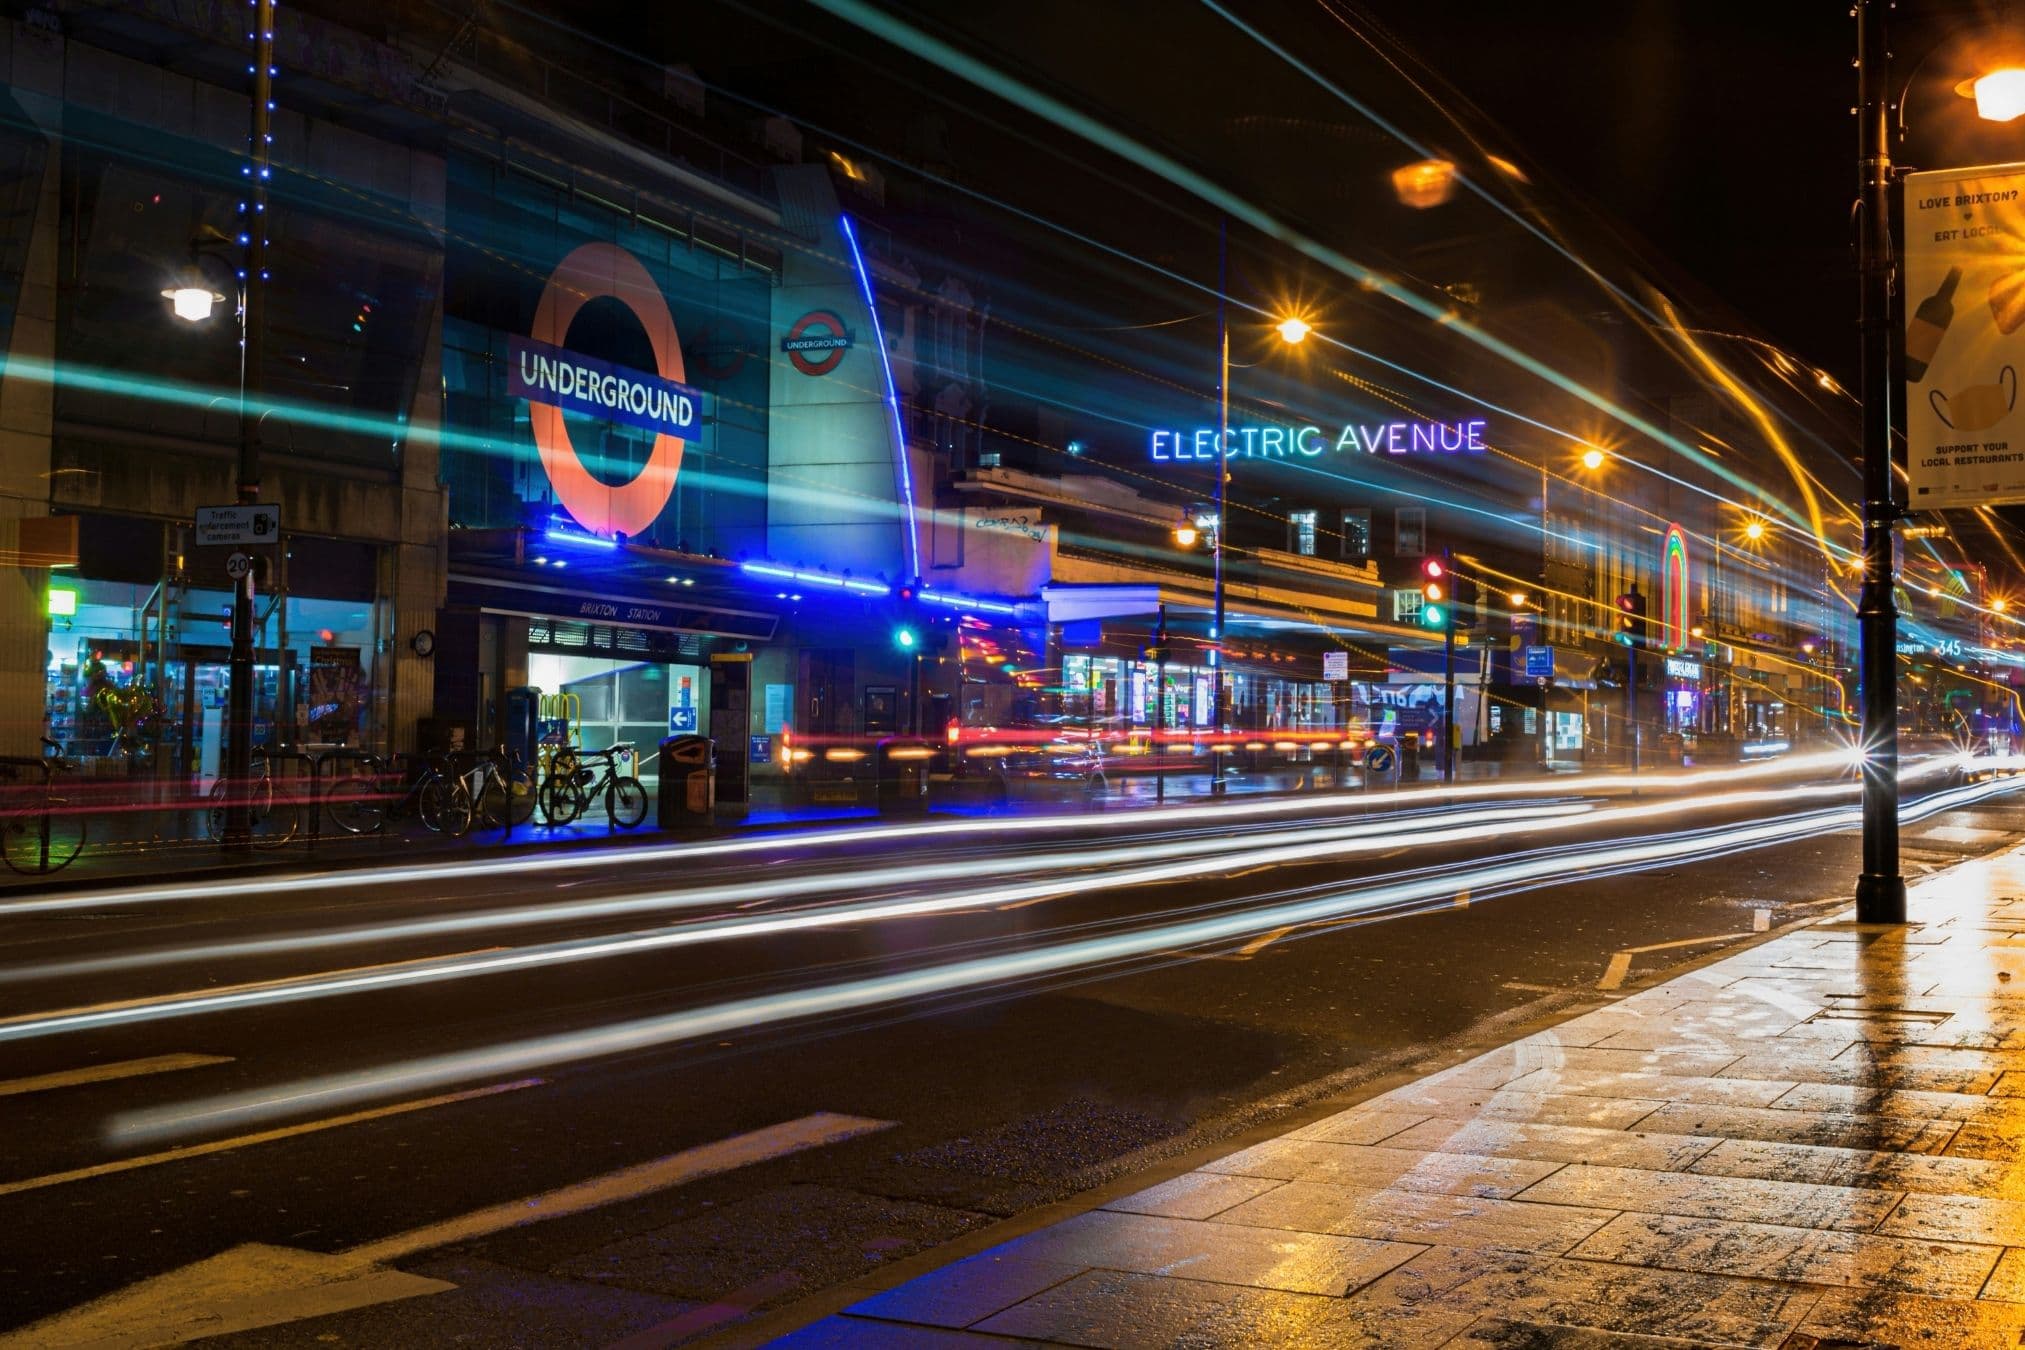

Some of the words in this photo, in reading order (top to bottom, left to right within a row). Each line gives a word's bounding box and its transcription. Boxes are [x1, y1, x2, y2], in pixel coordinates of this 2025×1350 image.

[1919, 196, 1951, 210] LOVE
[1955, 190, 2019, 207] BRIXTON?
[1934, 229, 1959, 242] EAT
[787, 338, 847, 350] UNDERGROUND
[521, 350, 693, 427] UNDERGROUND
[1151, 426, 1322, 460] ELECTRIC
[1336, 421, 1487, 454] AVENUE
[1936, 444, 1978, 455] SUPPORT
[1983, 441, 2008, 452] YOUR
[1921, 458, 1951, 468] LOCAL
[1954, 452, 2025, 465] RESTAURANTS
[211, 510, 237, 520] Traffic
[199, 521, 249, 530] forcement
[207, 532, 241, 541] cameras
[229, 559, 247, 573] 20
[580, 602, 618, 617] BRIXTON
[627, 607, 662, 621] STATION
[1940, 640, 1961, 656] 345
